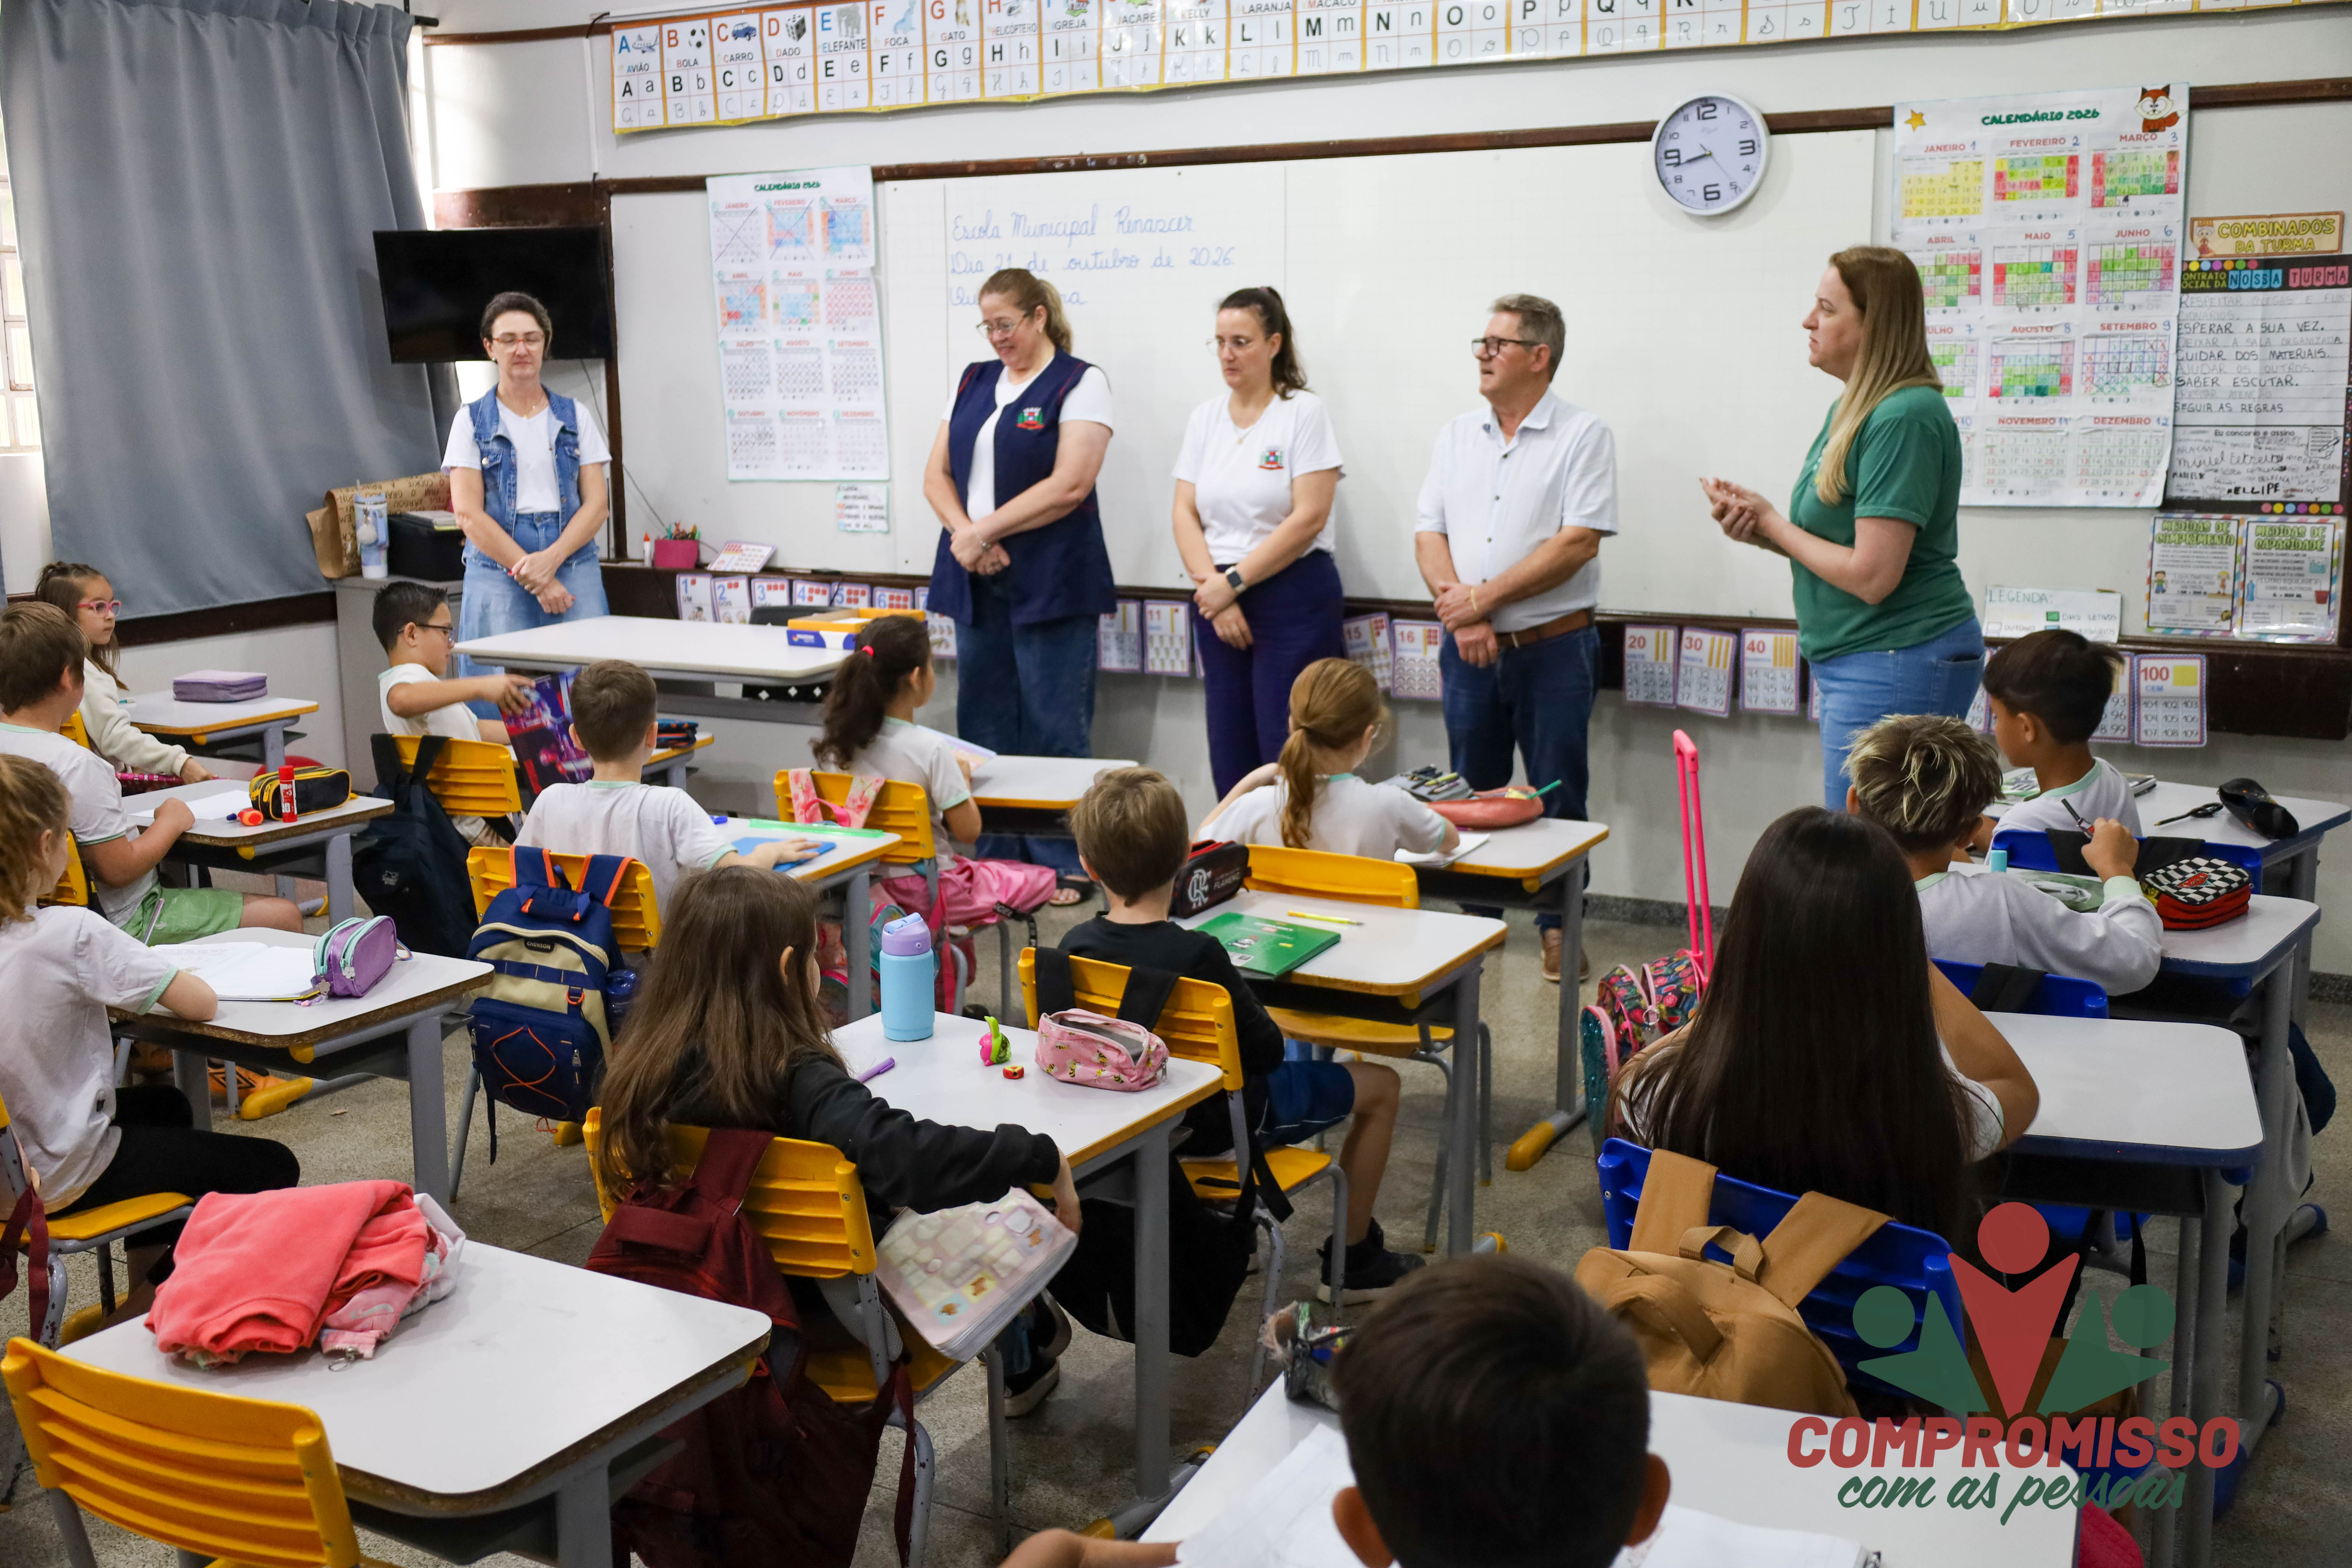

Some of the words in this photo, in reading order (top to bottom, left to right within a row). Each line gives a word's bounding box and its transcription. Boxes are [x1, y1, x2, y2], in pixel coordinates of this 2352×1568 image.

[931, 0, 944, 19] G
[1181, 9, 1210, 19] KELLY
[1243, 3, 1292, 14] LARANJA
[1523, 0, 1536, 19] P
[1559, 0, 1570, 17] p
[821, 12, 831, 31] E
[876, 6, 885, 25] F
[1117, 12, 1156, 25] JACARÉ
[1377, 12, 1389, 31] N
[1411, 12, 1421, 26] n
[1447, 6, 1462, 25] O
[1483, 6, 1495, 20] o
[769, 18, 779, 36] D
[992, 23, 1037, 37] HELICÓPTERO
[1054, 19, 1086, 30] IGREJA
[1242, 24, 1251, 41] L
[1276, 21, 1279, 39] l
[1306, 17, 1321, 36] M
[1337, 17, 1353, 31] m
[668, 30, 678, 47] B
[717, 23, 728, 41] C
[941, 31, 966, 42] GATO
[1175, 29, 1185, 46] K
[1206, 27, 1215, 44] k
[619, 35, 630, 54] A
[822, 39, 867, 53] ELEFANTE
[884, 37, 908, 47] FOCA
[723, 52, 753, 63] CARRO
[775, 47, 800, 57] DADO
[935, 50, 947, 67] G
[963, 47, 971, 64] g
[992, 44, 1002, 61] H
[1020, 42, 1029, 59] h
[626, 62, 650, 74] AVIÃO
[676, 58, 698, 68] BOLA
[825, 60, 834, 77] E
[851, 60, 859, 72] e
[881, 55, 888, 72] F
[908, 53, 913, 69] f
[723, 70, 733, 87] C
[749, 70, 756, 82] c
[774, 66, 783, 81] D
[797, 63, 805, 79] d
[622, 81, 632, 96] A
[646, 80, 654, 92] a
[672, 76, 682, 92] B
[697, 74, 704, 89] b
[1697, 103, 1717, 120] 12
[1981, 110, 2063, 125] CALENDÁRIO
[2067, 110, 2099, 120] 2026
[2010, 137, 2066, 147] FEVEREIRO
[2072, 136, 2080, 147] 2
[2119, 133, 2157, 143] MARÇO
[2171, 132, 2179, 142] 3
[1739, 139, 1755, 155] 3
[1924, 143, 1966, 152] JANEIRO
[1970, 141, 1976, 150] 1
[1664, 149, 1681, 167] 9
[754, 182, 800, 191] CALENDÁRIO
[1704, 184, 1720, 201] 6
[952, 209, 1000, 241] Escola
[1011, 203, 1099, 248] Municipal
[2164, 225, 2173, 236] 6
[2218, 219, 2336, 237] COMBINADOS
[1969, 234, 1976, 243] 4
[2068, 230, 2076, 240] 5
[2115, 229, 2150, 238] JUNHO
[2236, 240, 2255, 253] DA
[2261, 237, 2315, 252] TURMA
[951, 251, 983, 274] Dia
[994, 254, 1012, 271] 21
[1027, 251, 1049, 272] de
[1064, 248, 1140, 271] outubro
[1150, 246, 1174, 268] de
[2182, 272, 2226, 280] ONTRATO
[2230, 273, 2281, 286] NOSSA
[2292, 270, 2348, 283] TURMA
[1966, 325, 1974, 334] 7
[2064, 323, 2071, 333] 8
[2100, 322, 2157, 331] SETEMBRO
[2163, 321, 2171, 330] 9
[2178, 323, 2233, 334] ESPERAR
[2246, 324, 2253, 332] A
[2261, 323, 2285, 332] SUA
[2297, 321, 2324, 331] VEZ.
[2176, 351, 2225, 361] CUIDAR
[2236, 351, 2258, 360] DOS
[2269, 348, 2330, 359] MATERIAIS.
[2177, 377, 2220, 386] SABER
[2233, 375, 2298, 387] ESCUTAR.
[2175, 404, 2212, 412] SEGUIR
[2241, 404, 2283, 412] REGRAS
[1961, 417, 1972, 426] 10
[1998, 417, 2056, 425] NOVEMBRO
[2093, 417, 2151, 425] DEZEMBRO
[2156, 416, 2169, 426] 12
[2162, 521, 2211, 532] MEDIDAS
[2216, 522, 2231, 533] DE
[2256, 525, 2306, 537] MEDIDAS
[2311, 527, 2327, 538] DE
[2156, 533, 2235, 545] COMPRIMENTO
[2254, 539, 2324, 550] CAPACIDADE
[682, 578, 688, 594] 1
[717, 584, 727, 600] 2
[758, 585, 765, 600] 3
[797, 587, 805, 602] 4
[835, 588, 844, 603] 5
[878, 593, 886, 608] 6
[1989, 590, 2053, 603] LEGENDA:
[1399, 631, 1414, 643] 16
[1628, 635, 1646, 649] 20
[1684, 637, 1703, 651] 30
[1747, 640, 1765, 653] 40
[2141, 666, 2169, 681] 100
[2112, 697, 2126, 706] 93
[2112, 710, 2126, 720] 96
[2111, 724, 2126, 733] 99
